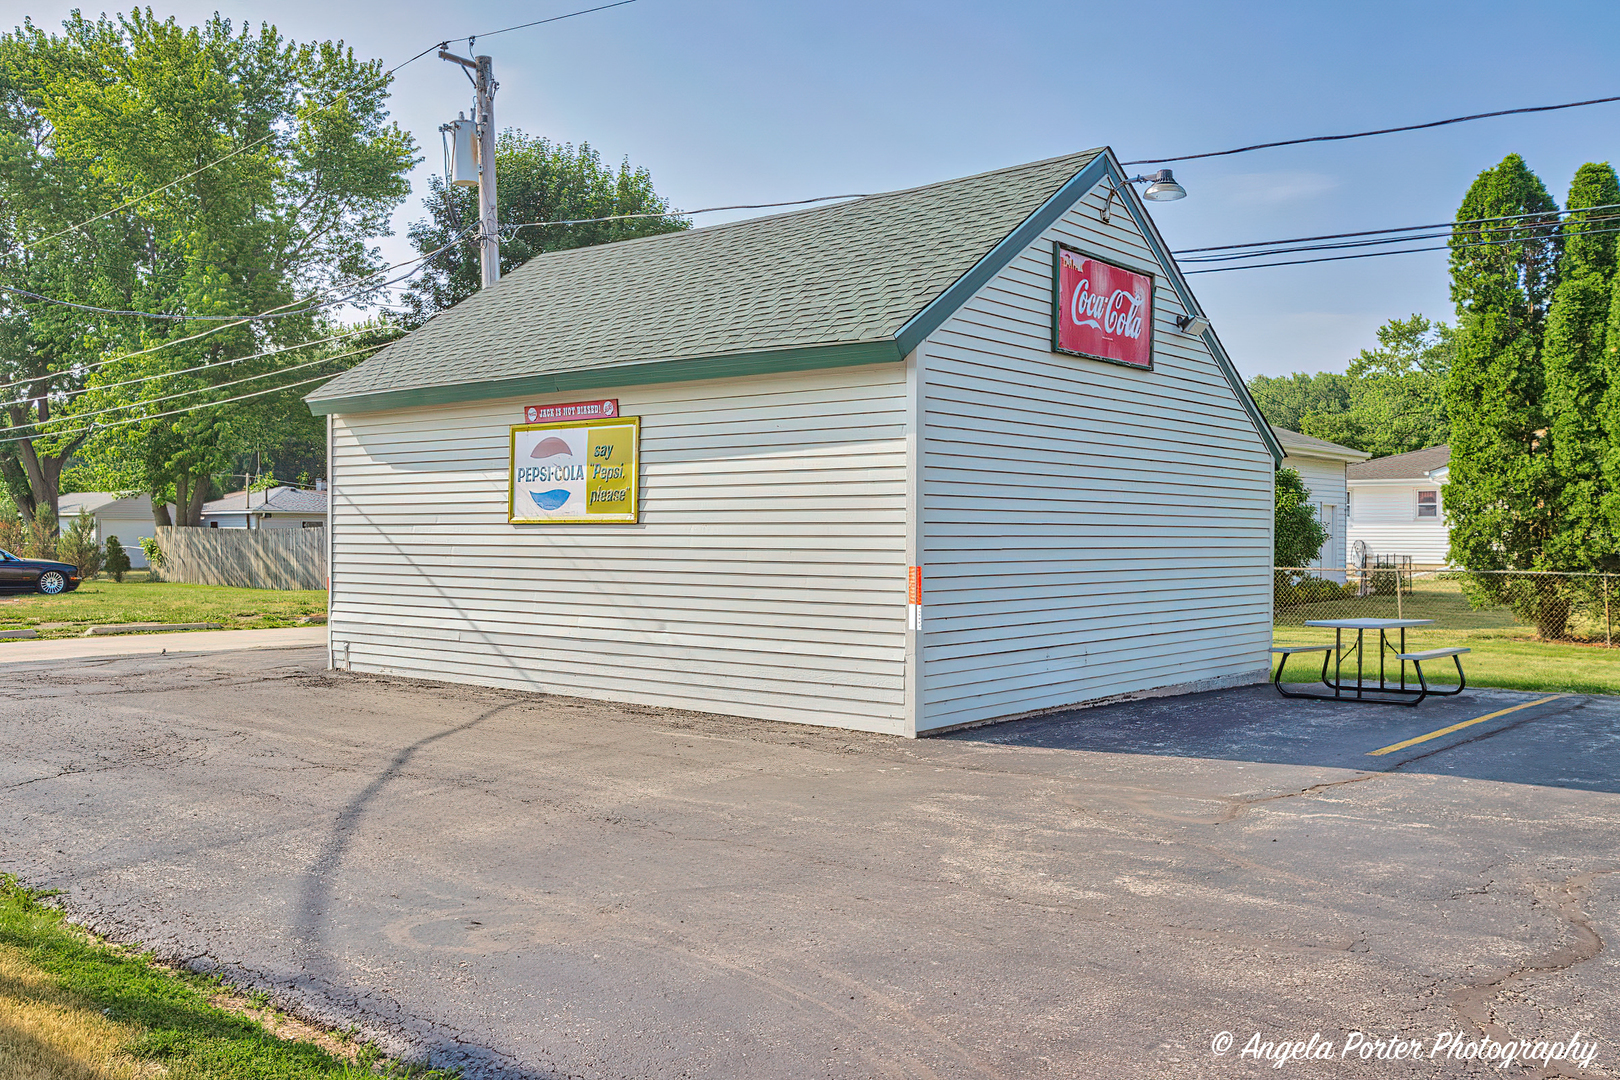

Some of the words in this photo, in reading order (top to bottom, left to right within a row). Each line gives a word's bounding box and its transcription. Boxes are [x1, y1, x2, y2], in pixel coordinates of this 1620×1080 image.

[540, 408, 554, 418] JACK
[555, 408, 562, 417] IS
[563, 406, 576, 416] NOT
[576, 405, 601, 415] BIASED!
[594, 445, 614, 460] say
